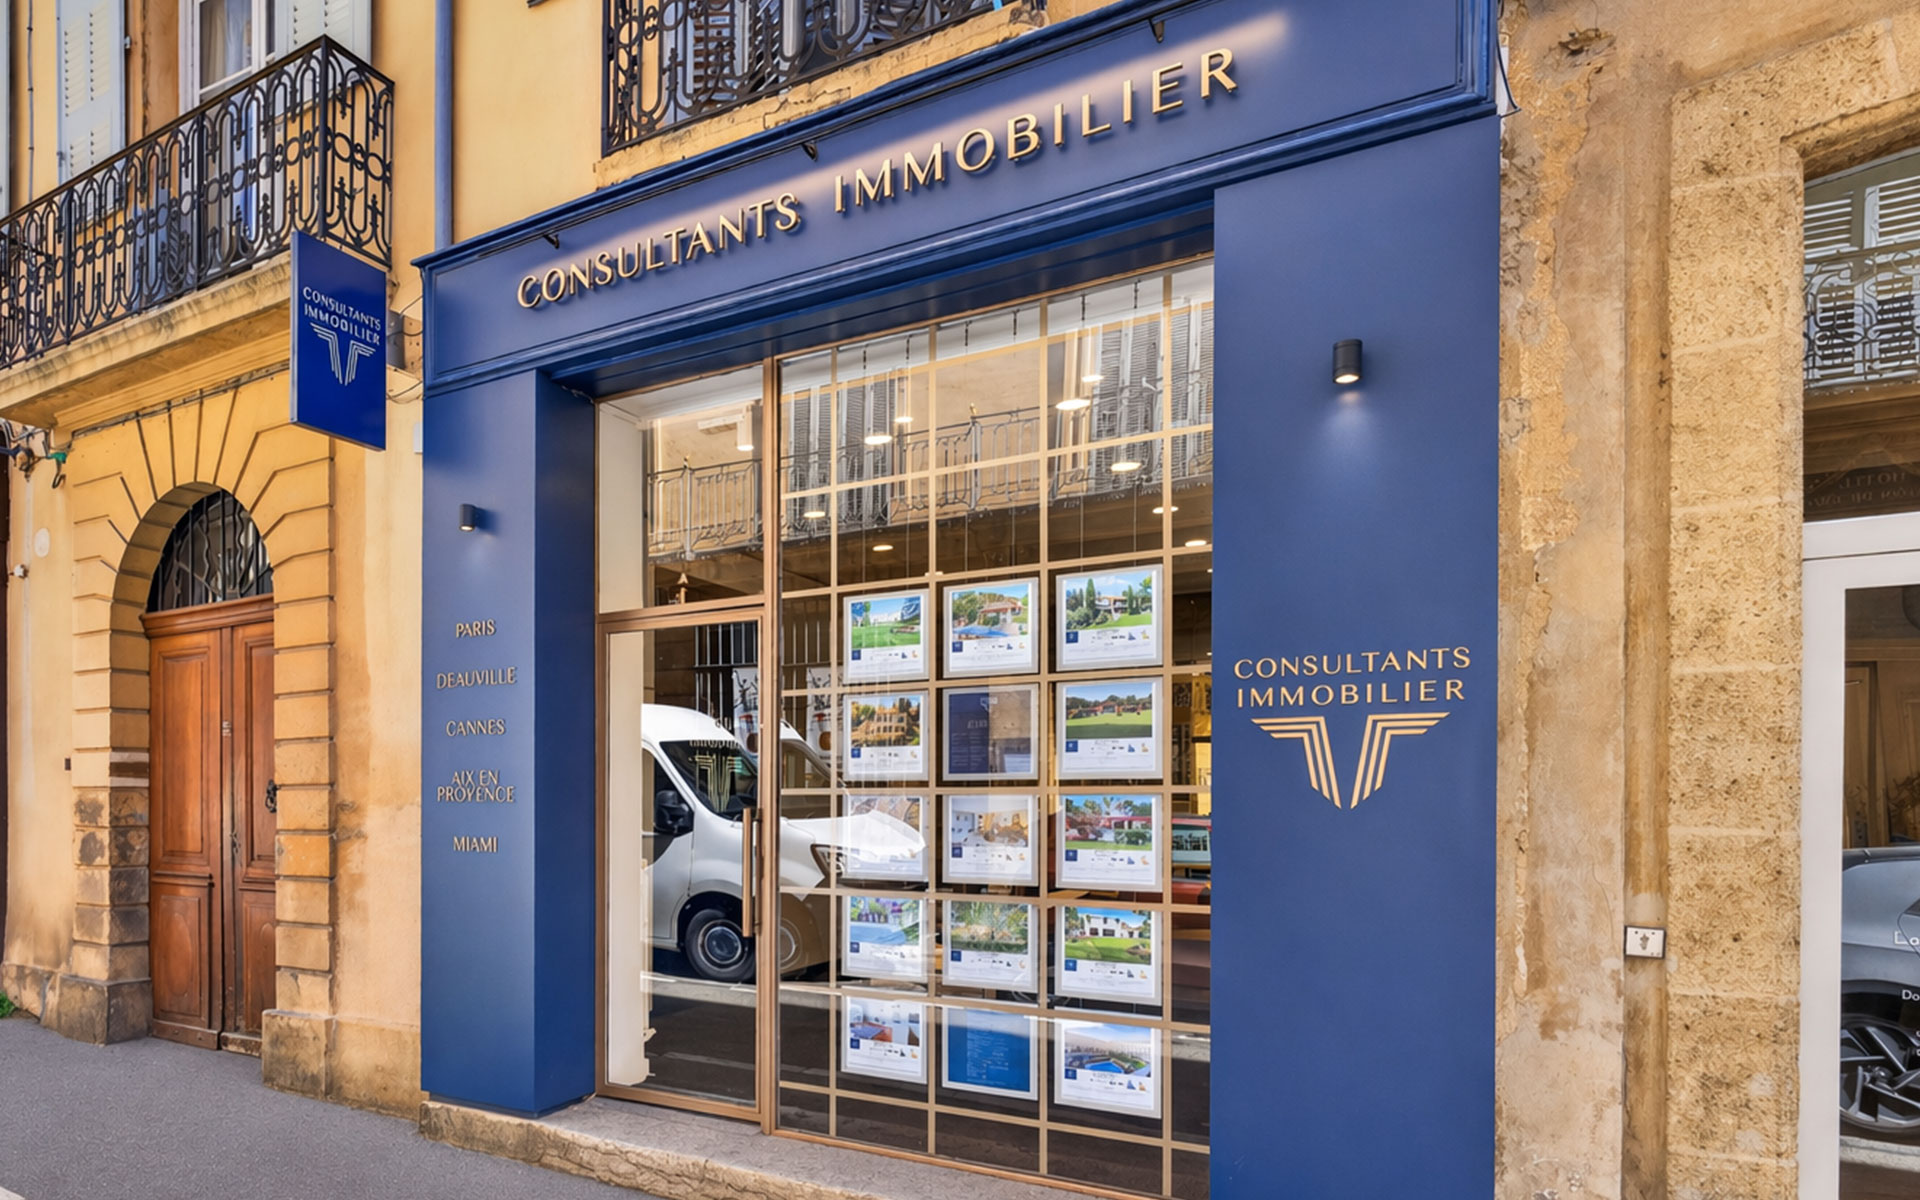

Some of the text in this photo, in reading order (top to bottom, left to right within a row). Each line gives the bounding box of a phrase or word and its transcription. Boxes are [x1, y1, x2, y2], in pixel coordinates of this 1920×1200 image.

[517, 48, 1238, 308] CONSULTANTS IMMOBILIER
[302, 286, 381, 331] CONSULTANTS
[455, 619, 496, 638] PARIS
[1233, 646, 1471, 680] CONSULTANTS
[436, 666, 517, 689] DEAUVILLE
[1237, 679, 1465, 708] IMMOBILIER
[446, 719, 505, 737] CANNES
[451, 769, 499, 786] AIX EN
[437, 786, 515, 802] PROVENCE
[453, 836, 498, 853] MIAMI
